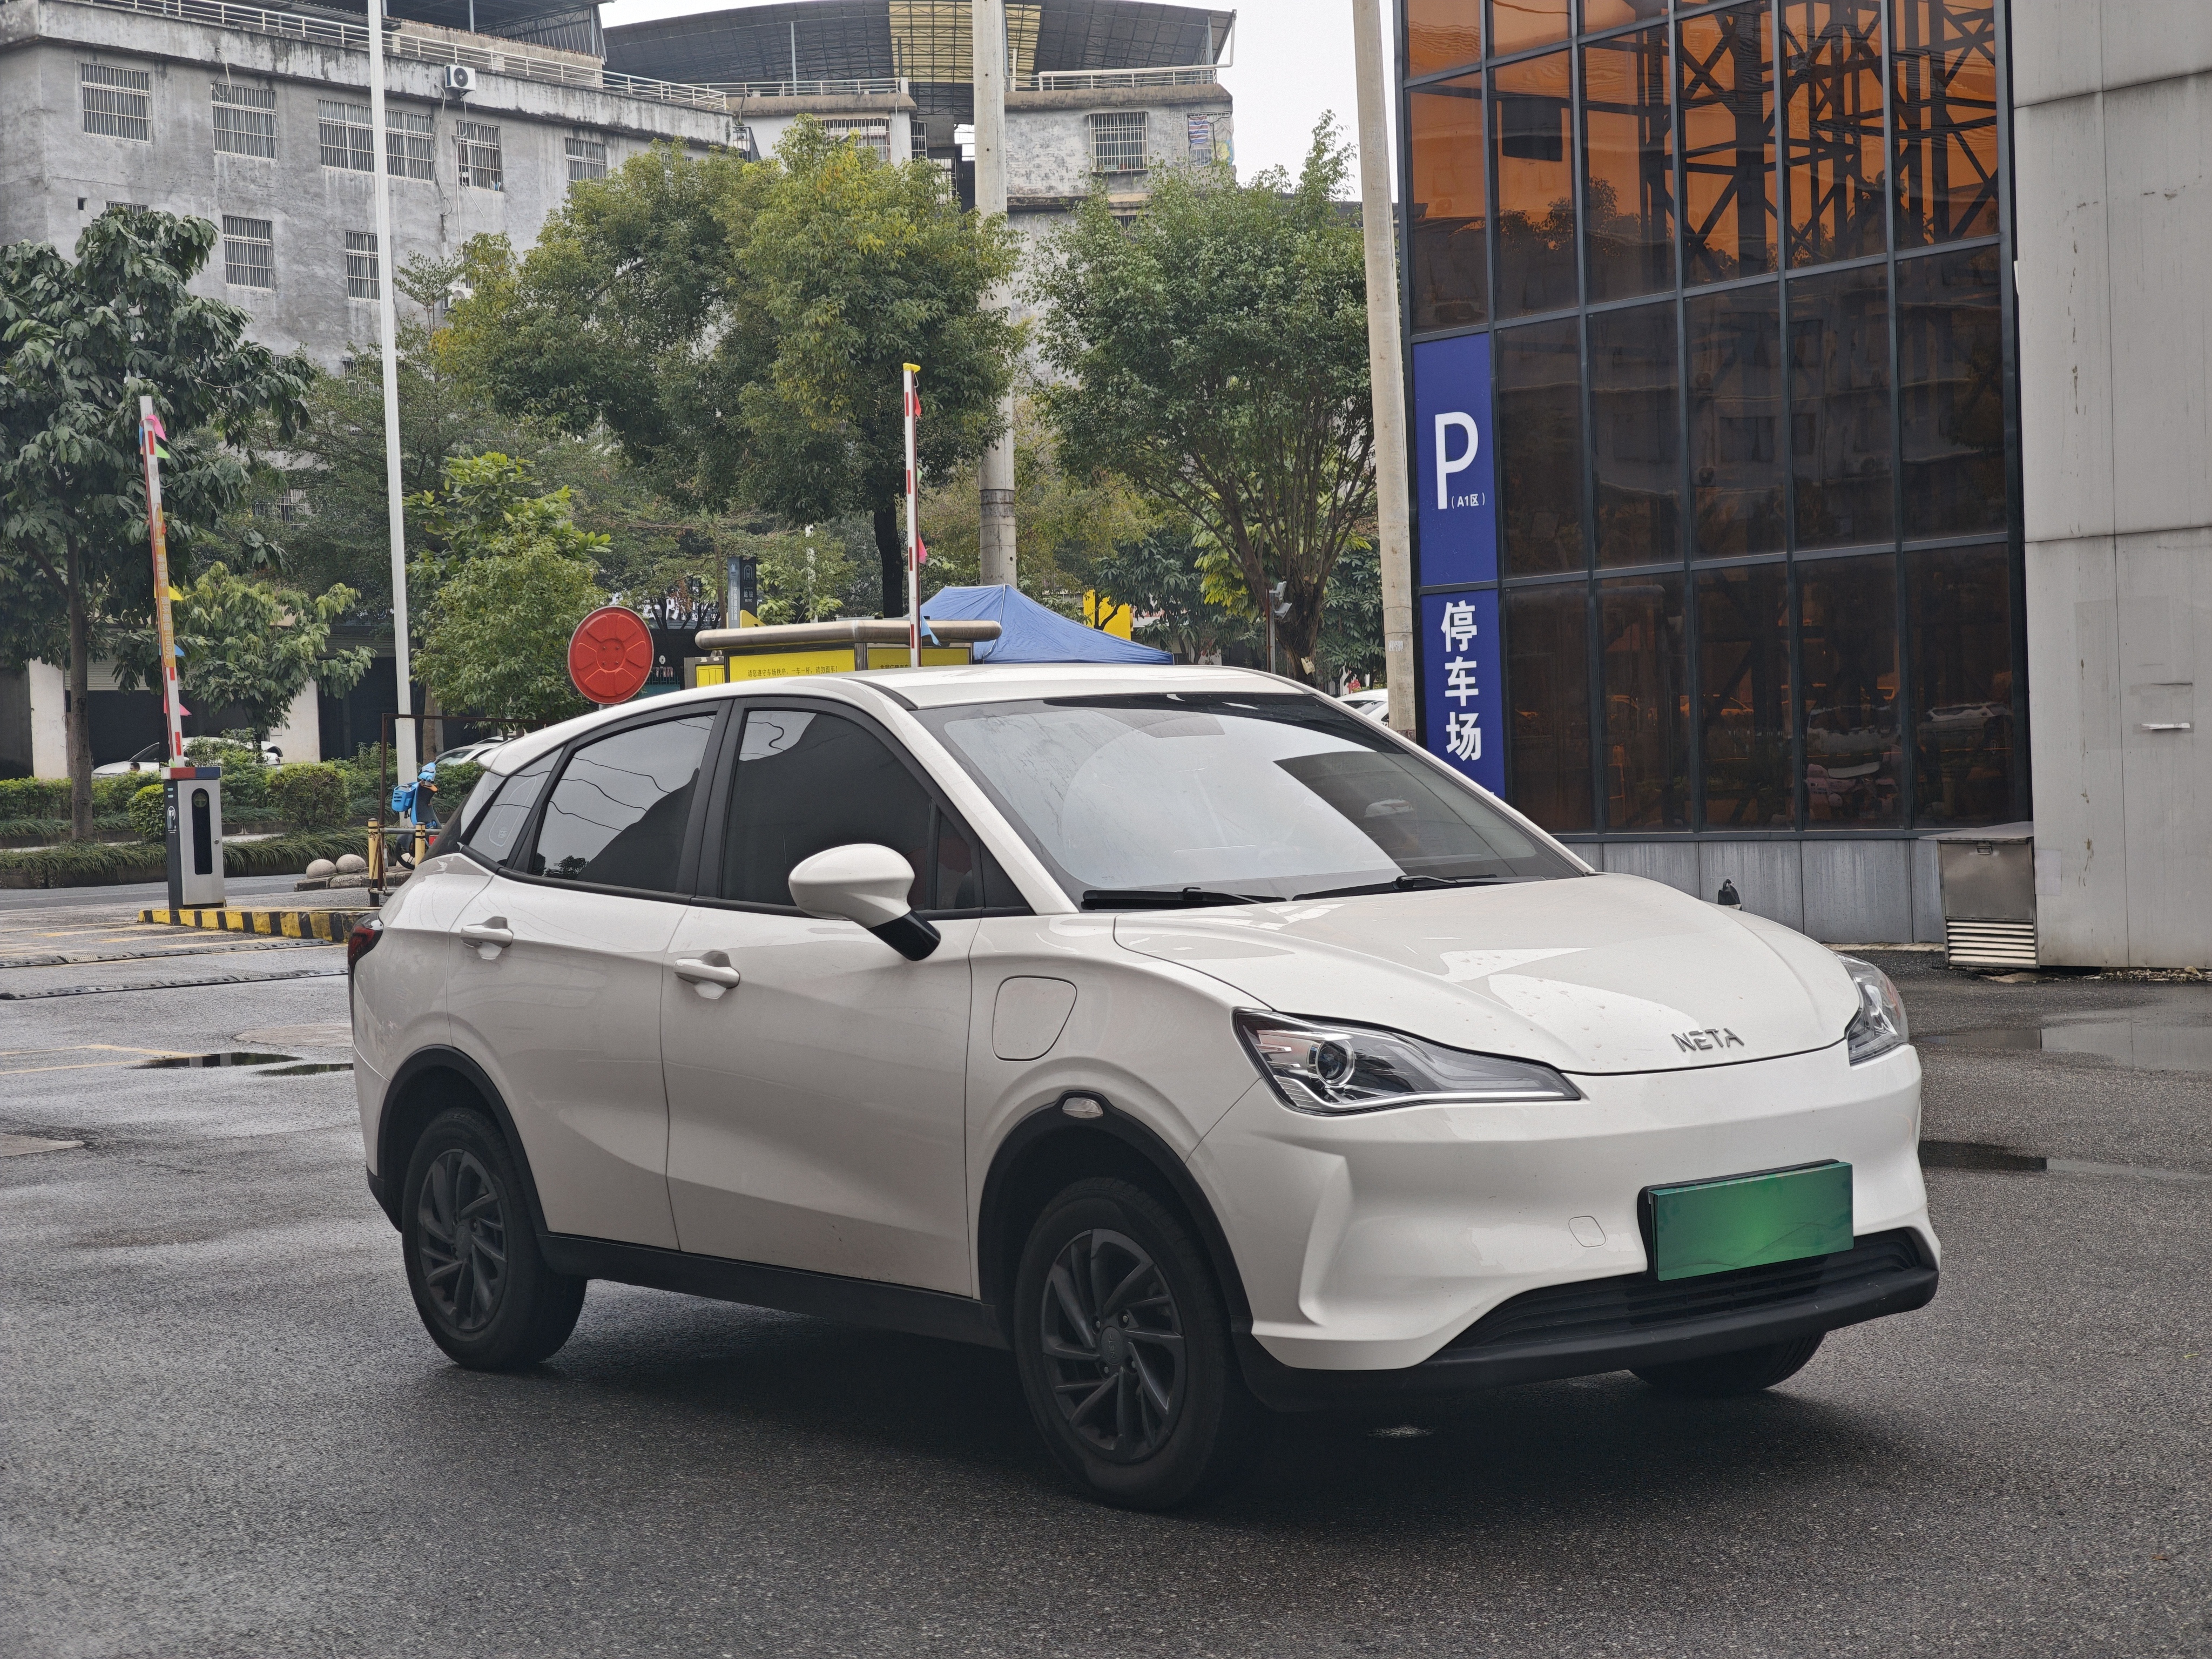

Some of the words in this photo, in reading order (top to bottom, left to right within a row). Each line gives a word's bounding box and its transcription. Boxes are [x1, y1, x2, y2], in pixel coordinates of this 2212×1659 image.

[1435, 411, 1479, 510] P
[1440, 599, 1481, 761] 停车场
[1671, 1027, 1745, 1052] NETA
